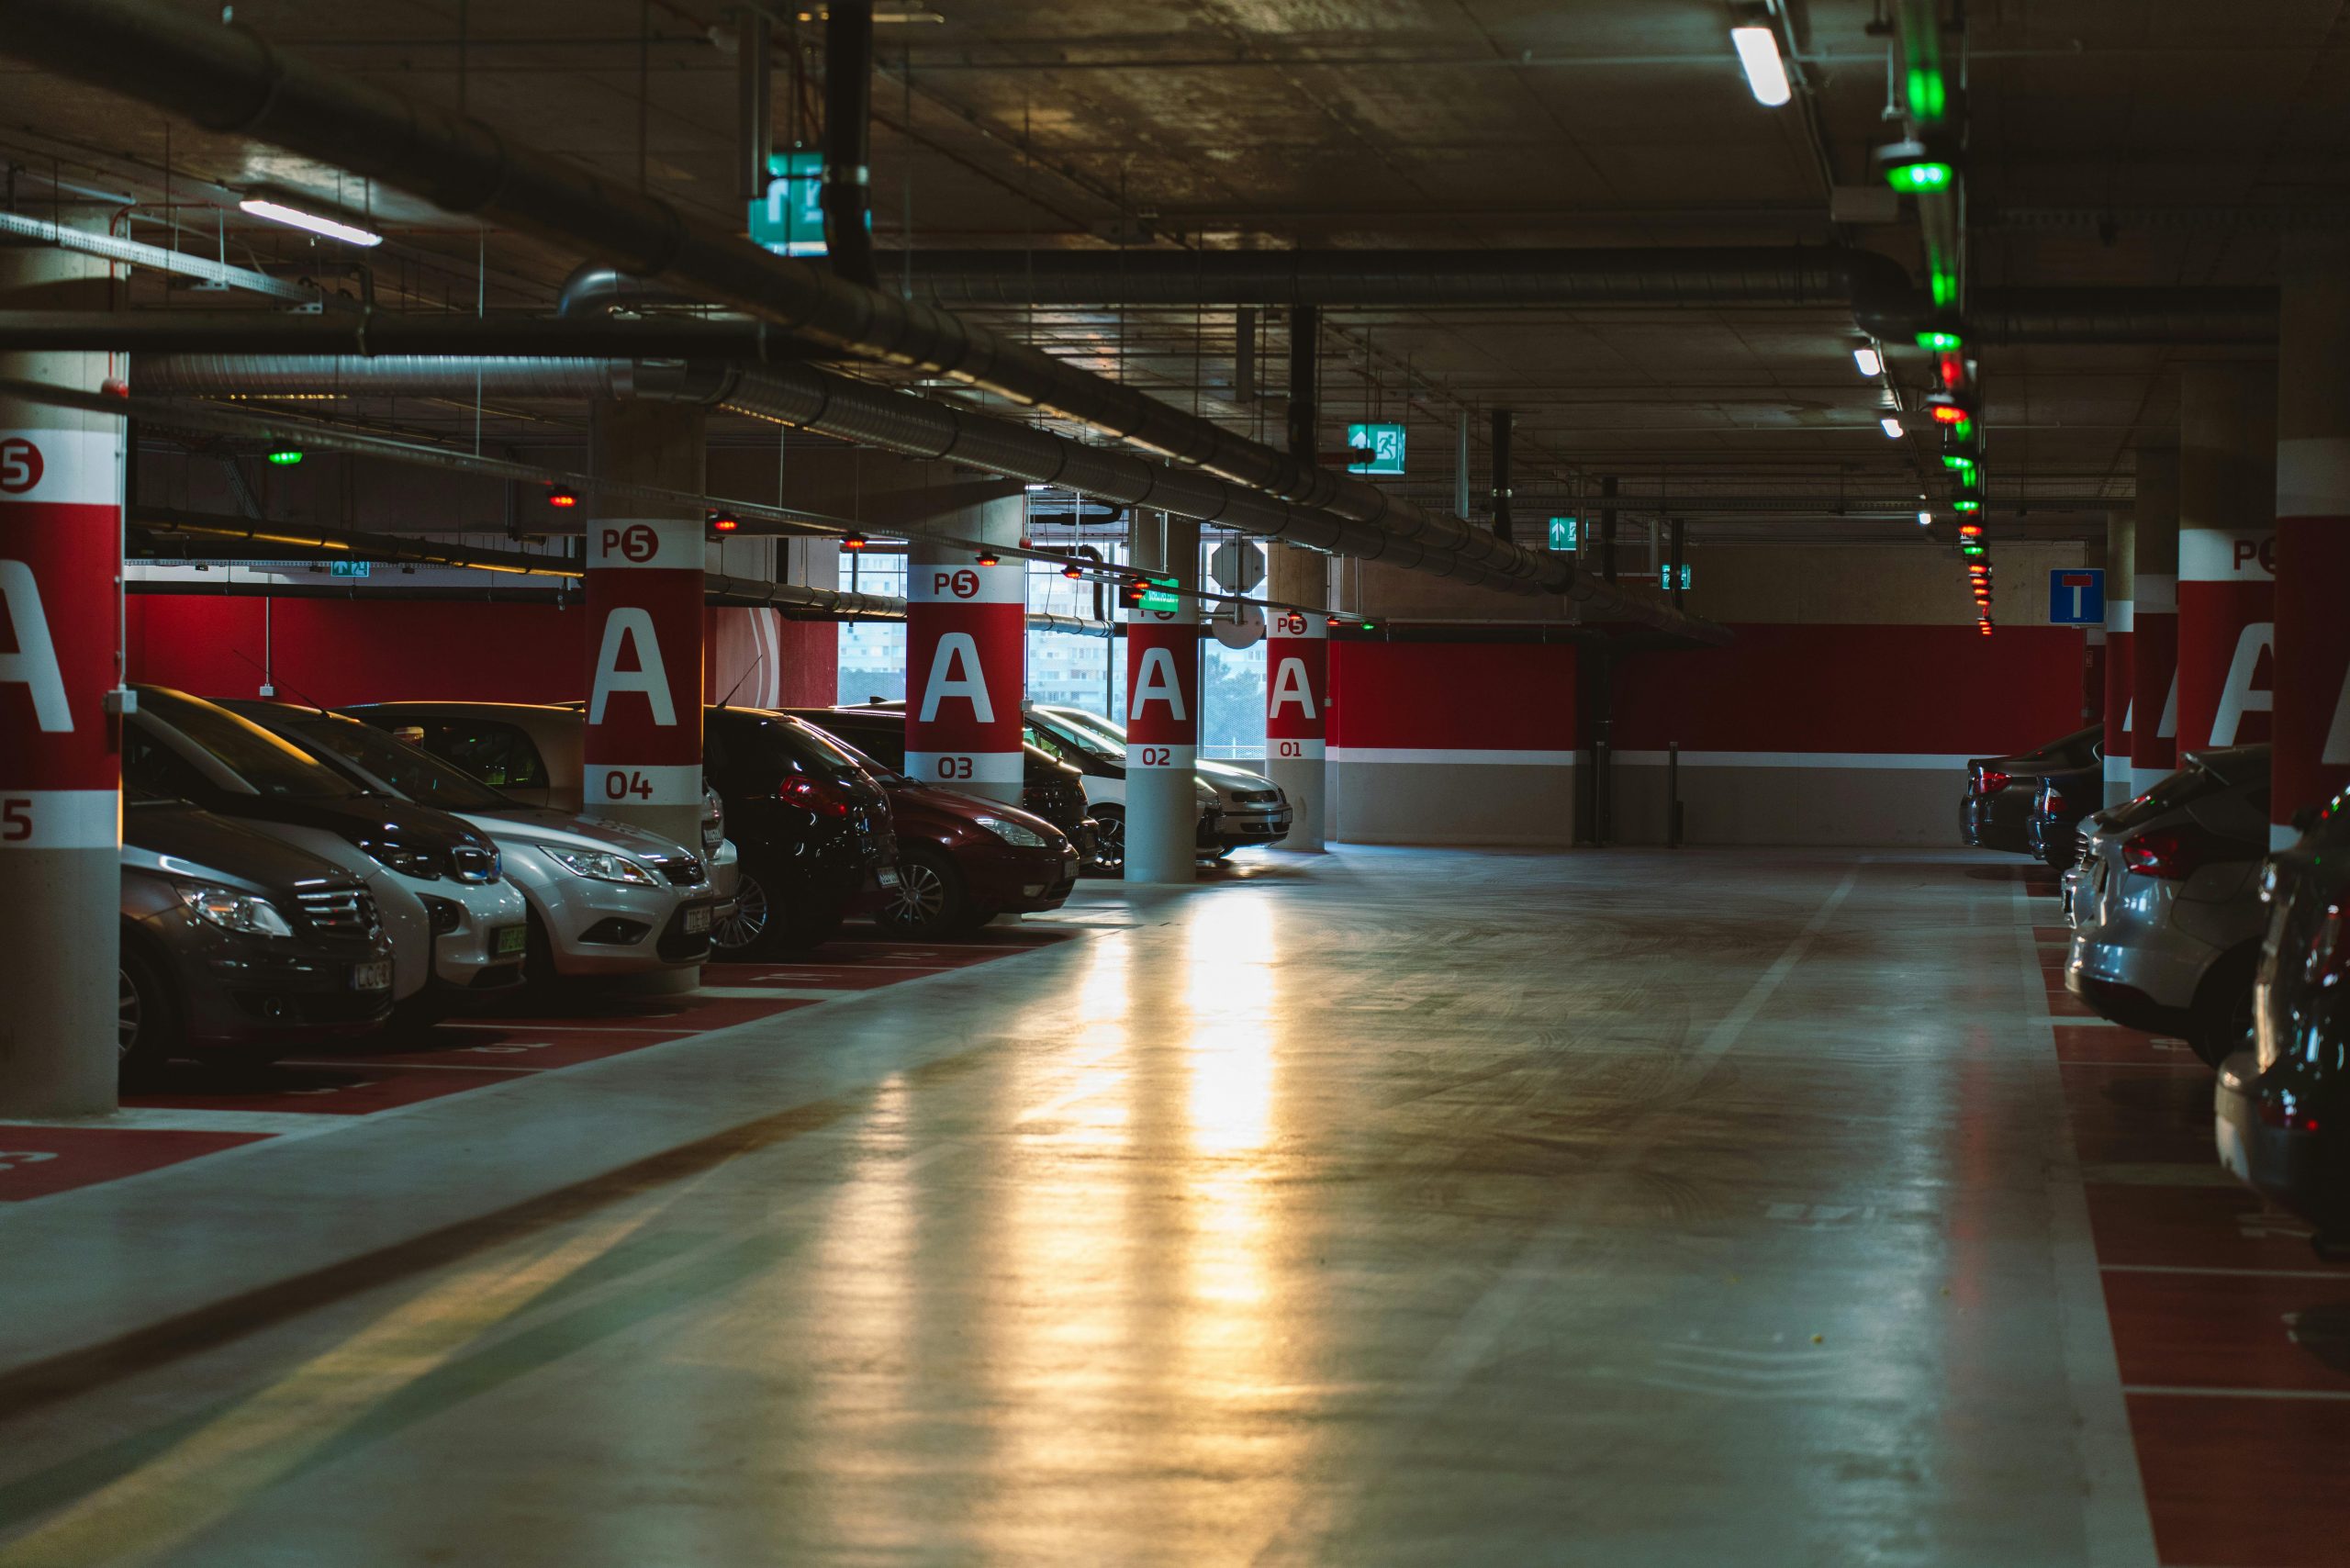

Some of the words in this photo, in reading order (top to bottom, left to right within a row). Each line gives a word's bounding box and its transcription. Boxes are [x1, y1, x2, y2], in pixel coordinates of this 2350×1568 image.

[603, 526, 655, 561] P5
[934, 571, 977, 597] P5
[1278, 617, 1305, 633] P5
[0, 559, 74, 732] A
[588, 607, 677, 726] A
[919, 632, 995, 723] A
[1131, 647, 1187, 721] A
[2208, 622, 2274, 746] A
[1269, 657, 1316, 719] A
[1142, 748, 1170, 767] 02
[1280, 742, 1303, 757] 01
[937, 756, 973, 779] 03
[606, 770, 654, 801] 04
